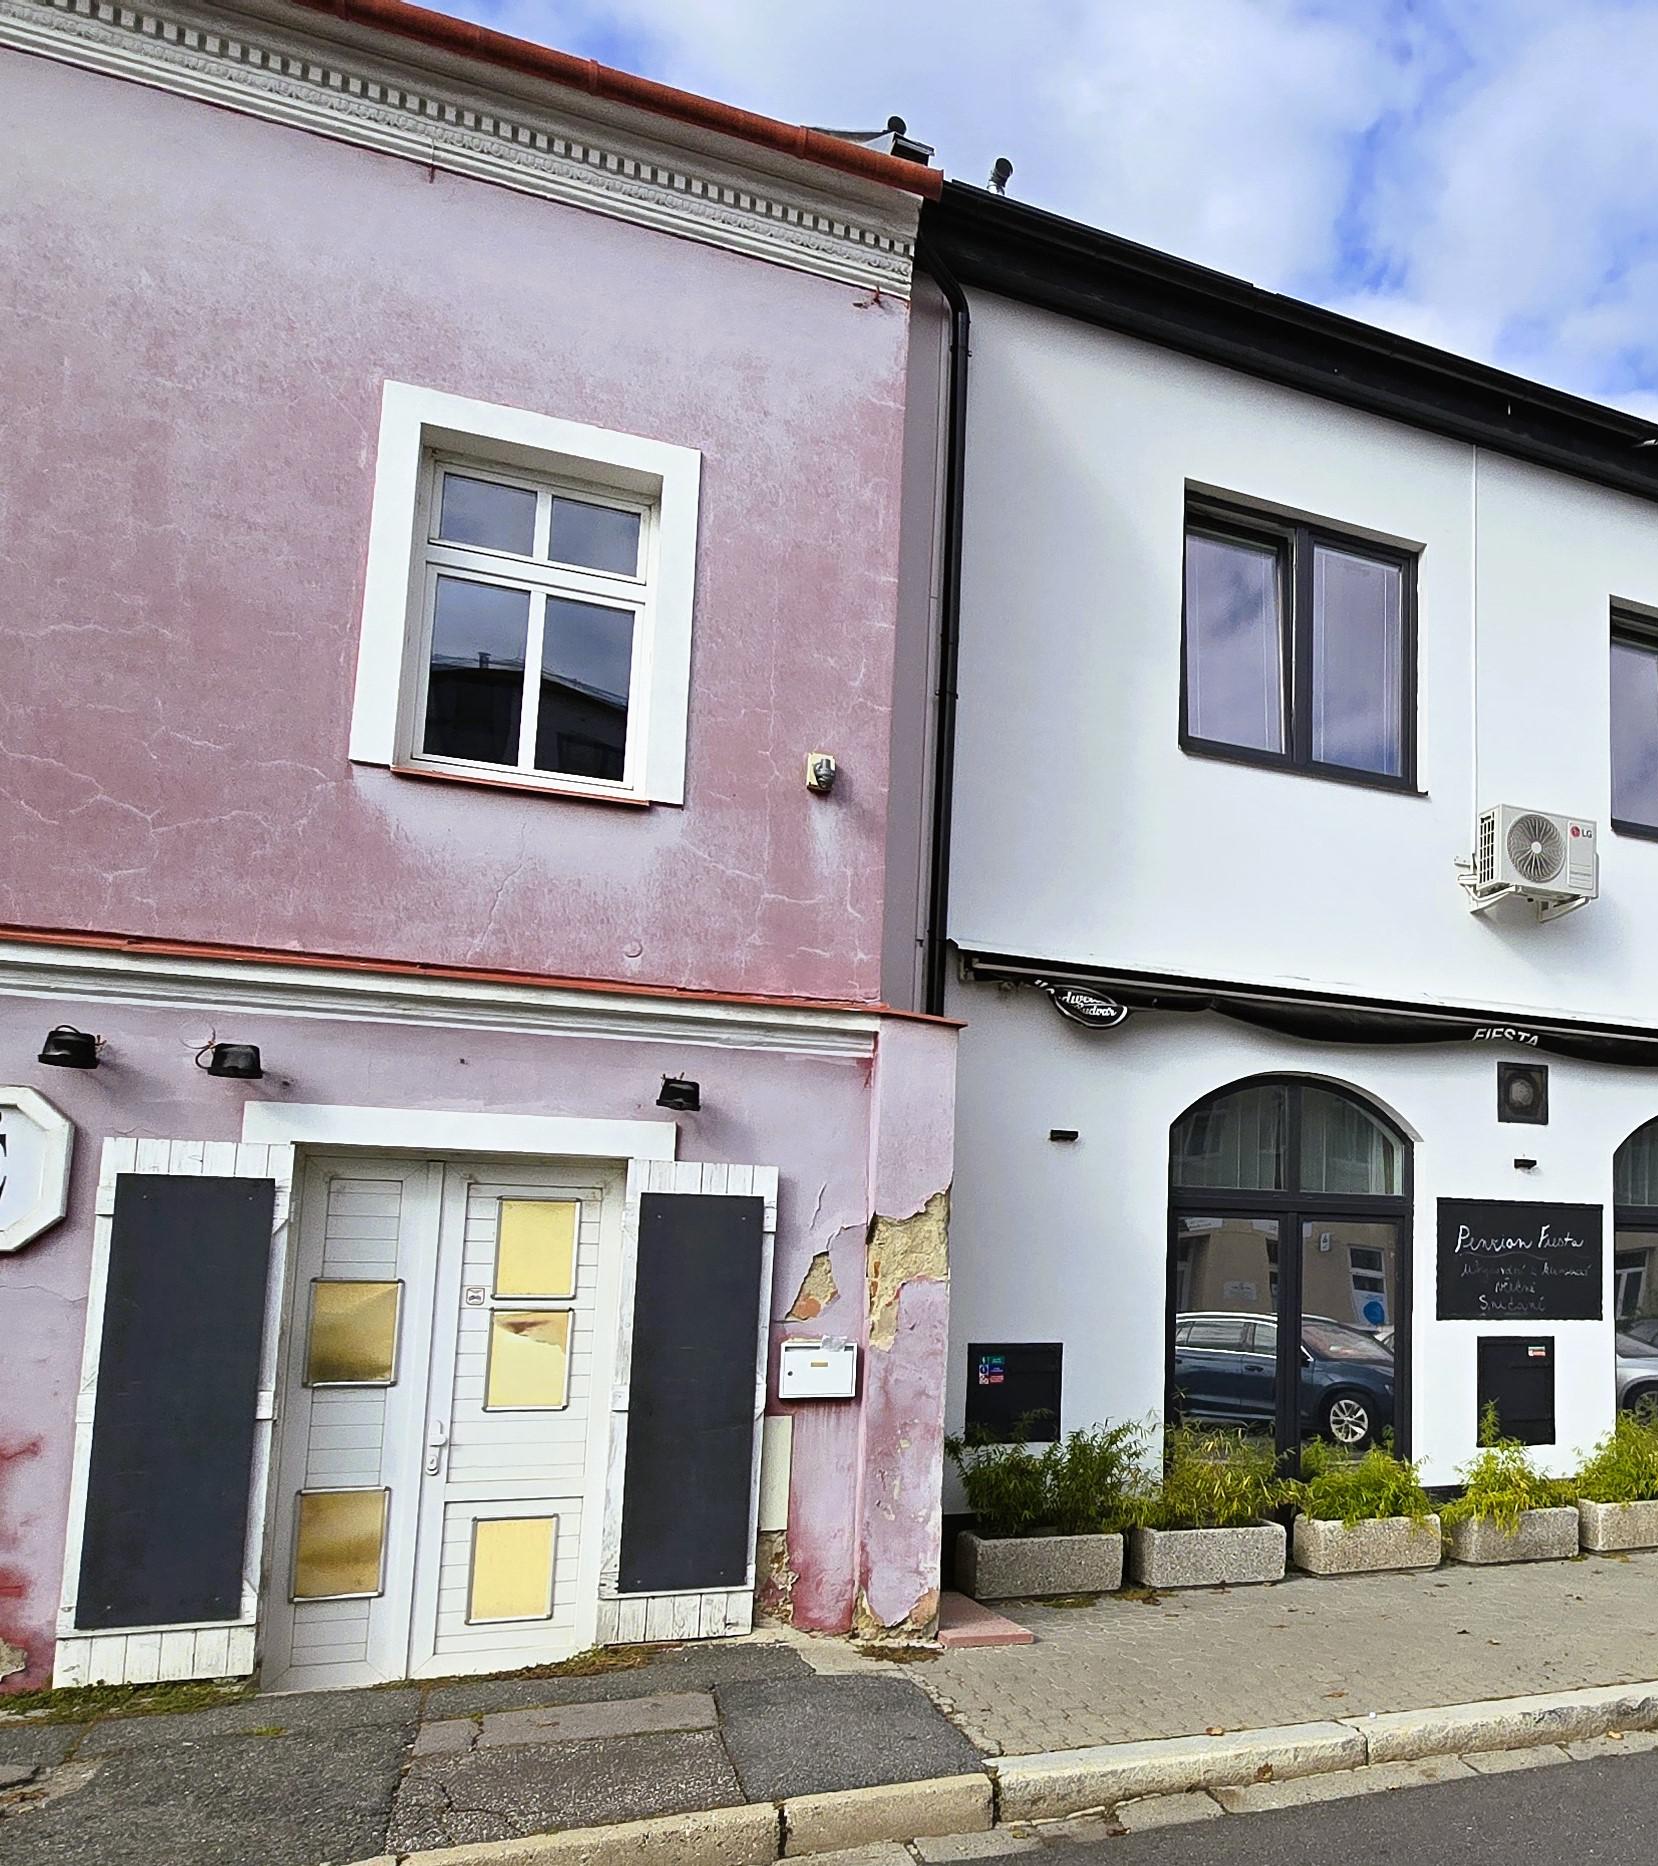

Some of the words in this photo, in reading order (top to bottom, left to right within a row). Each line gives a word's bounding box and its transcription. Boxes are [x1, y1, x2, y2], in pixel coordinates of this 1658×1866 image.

[1581, 830, 1593, 839] LG
[1454, 1224, 1533, 1253] Penzion
[1537, 1223, 1585, 1249] Fiesta
